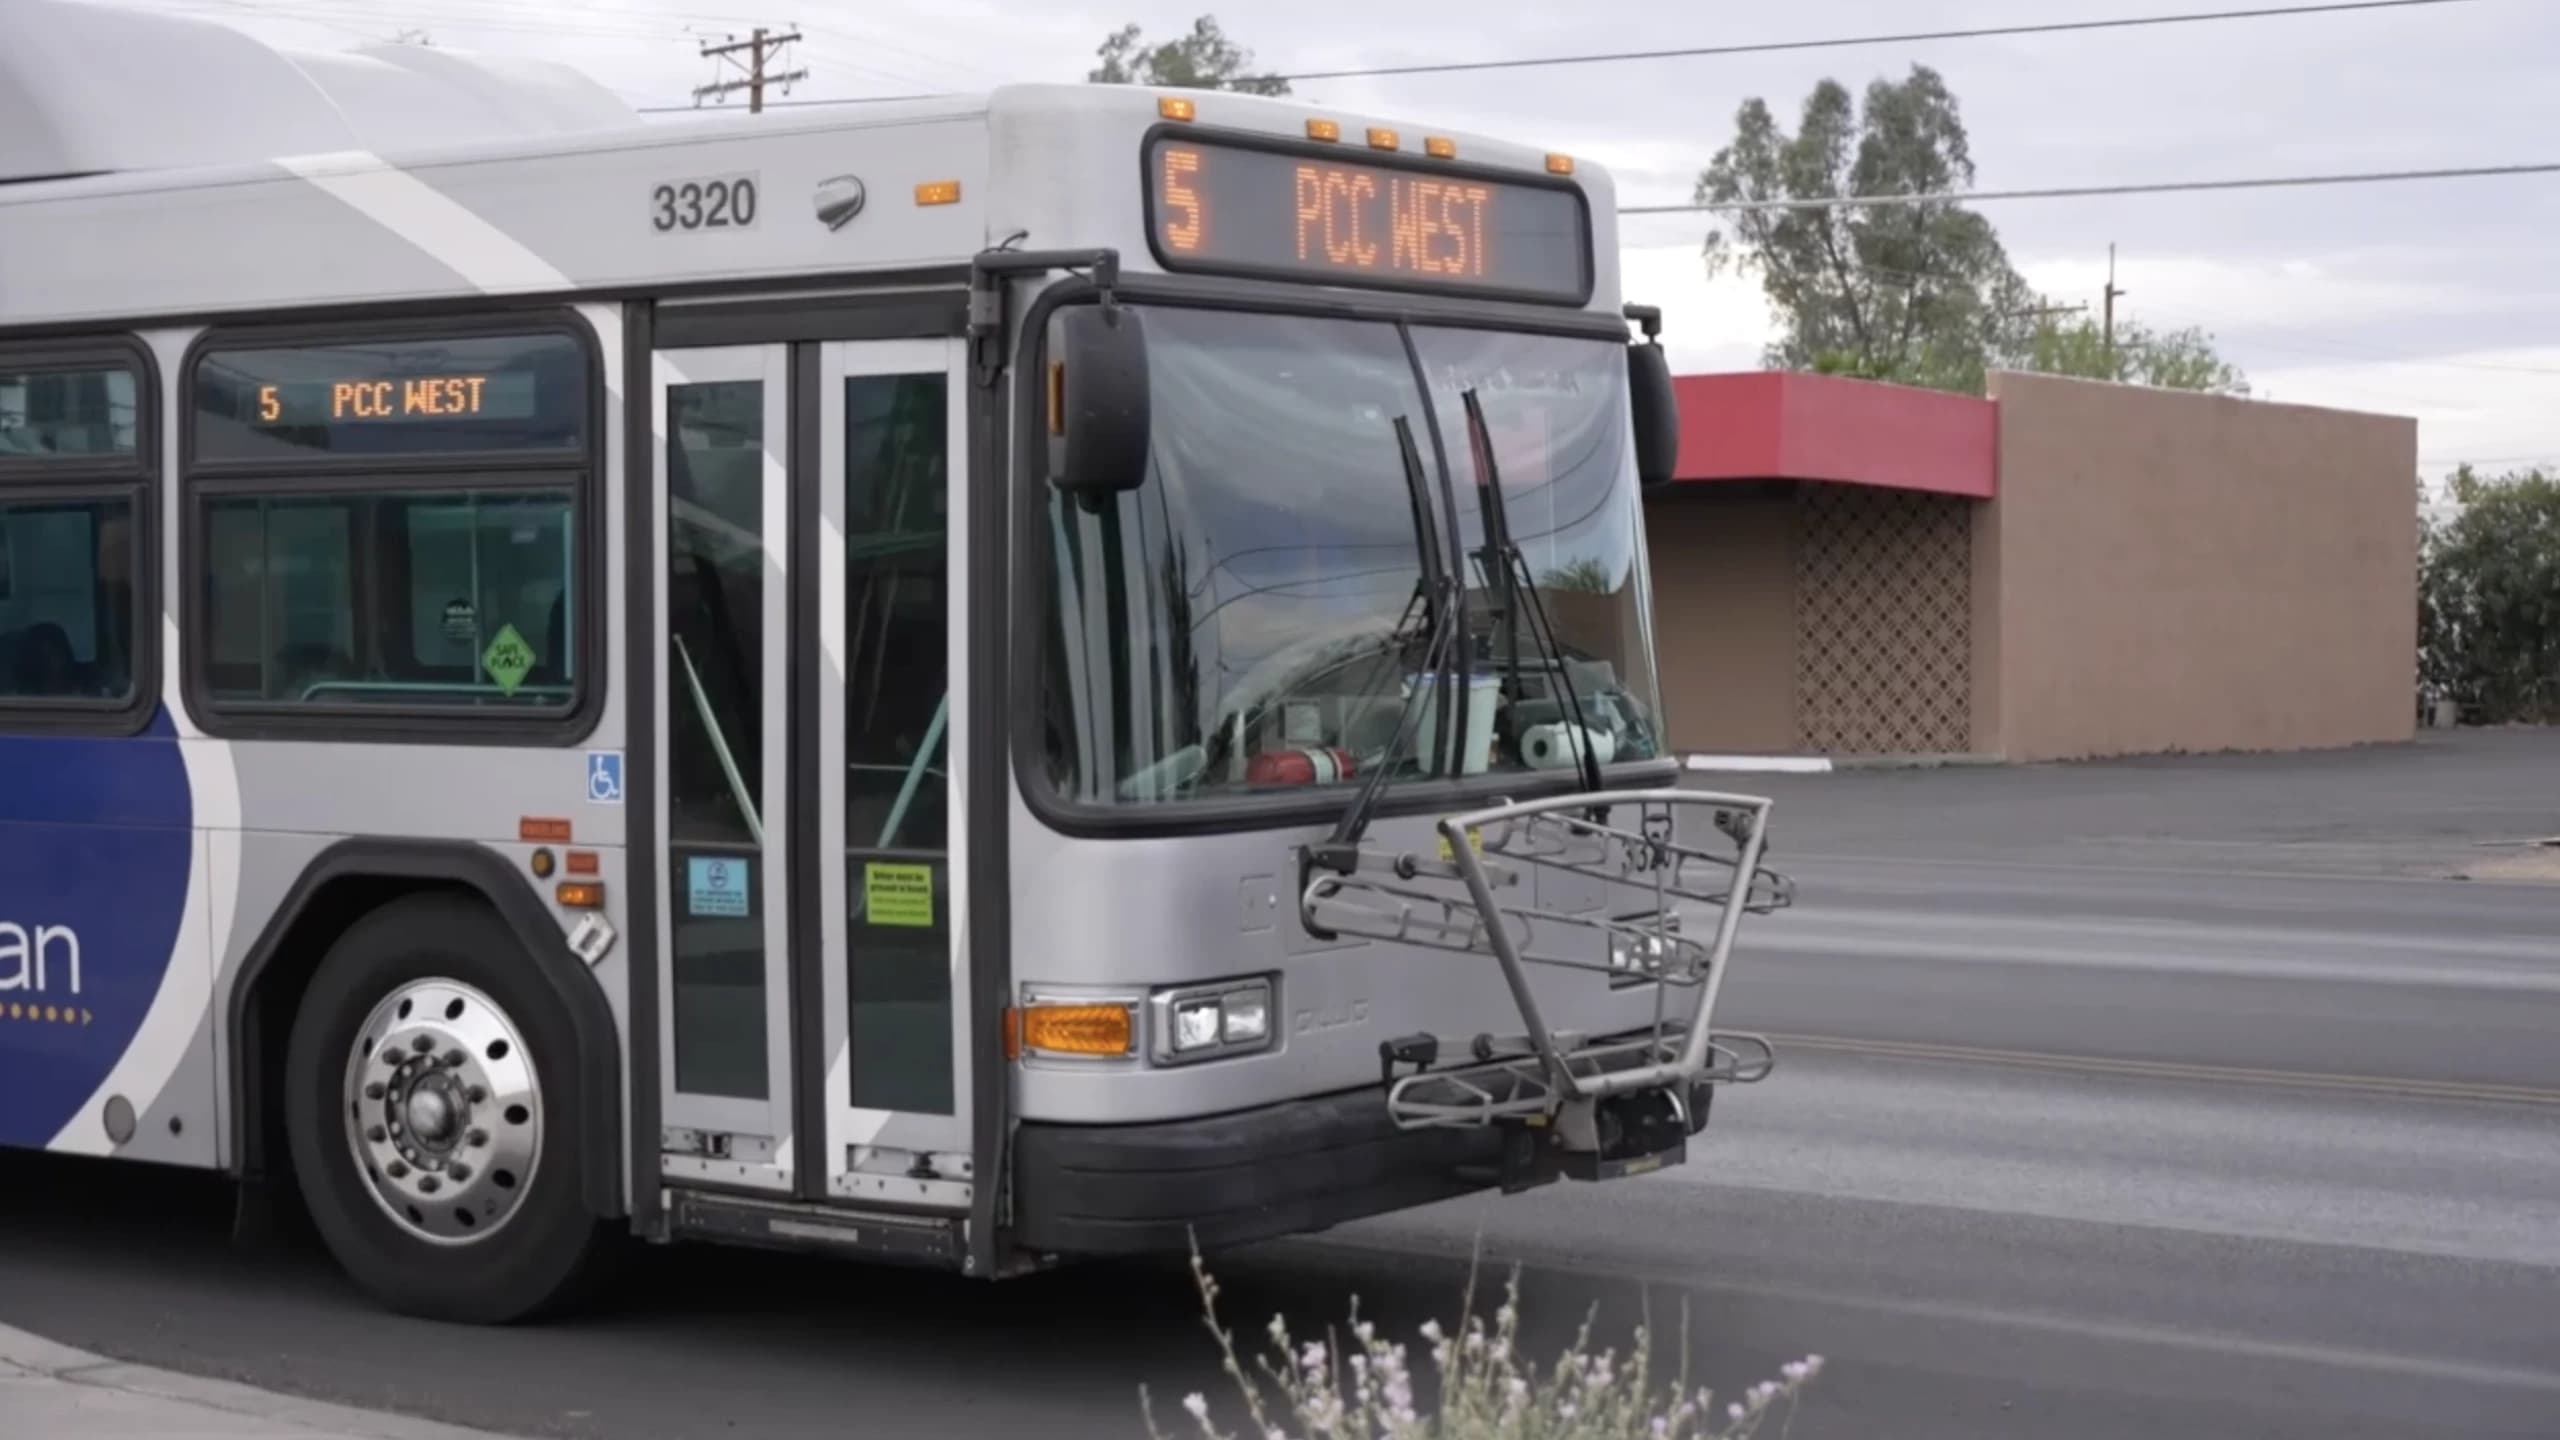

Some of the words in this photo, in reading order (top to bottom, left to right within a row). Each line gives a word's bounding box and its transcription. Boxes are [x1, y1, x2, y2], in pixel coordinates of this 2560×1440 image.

[653, 178, 756, 232] 3320
[1164, 150, 1201, 250] 5
[1295, 166, 1377, 266] PCC
[1391, 178, 1488, 276] WEST
[260, 386, 281, 421] 5
[333, 381, 394, 418] PCC
[404, 377, 486, 415] WEST
